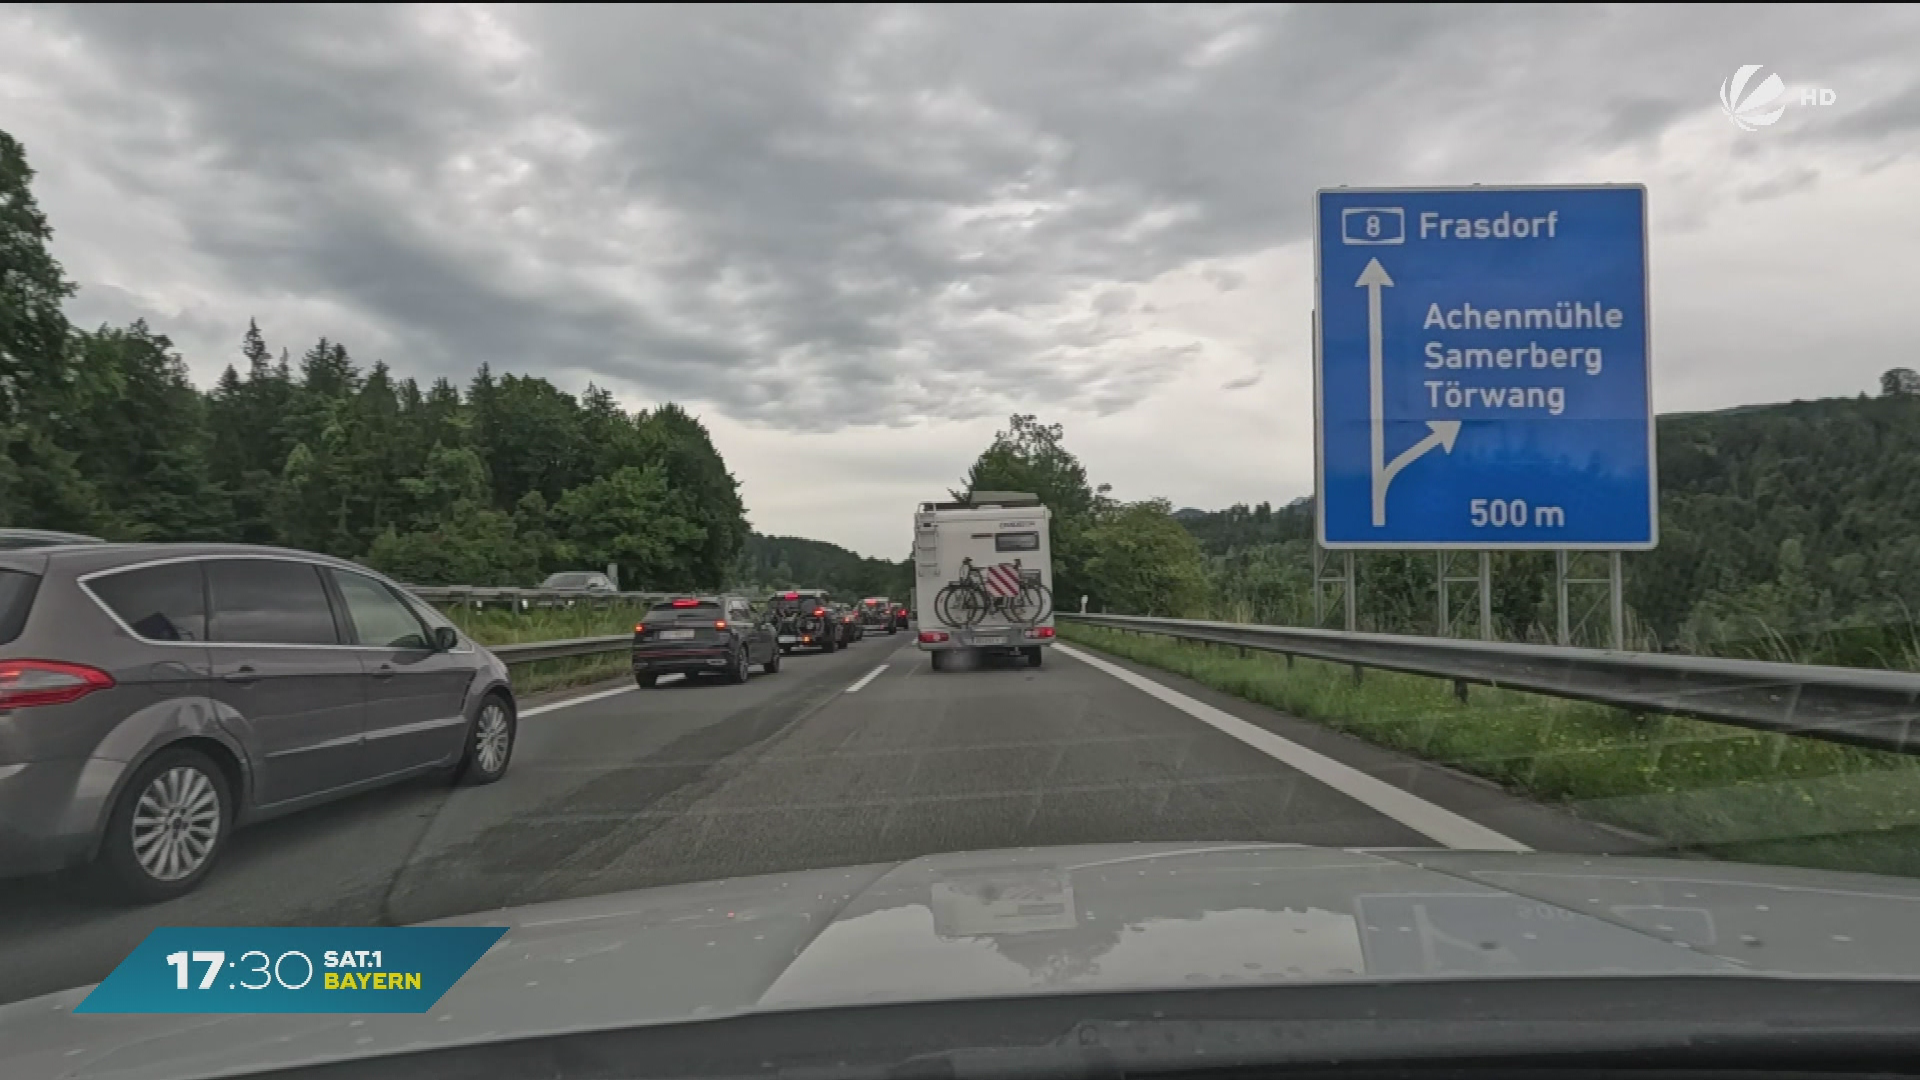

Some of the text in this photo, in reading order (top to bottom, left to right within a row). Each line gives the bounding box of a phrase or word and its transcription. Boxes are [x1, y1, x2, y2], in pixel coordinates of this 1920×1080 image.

[1365, 215, 1381, 237] 8
[1419, 211, 1558, 240] Frasdorf
[1423, 302, 1623, 330] Achenmühle
[1424, 342, 1602, 375] Samerberg
[1424, 381, 1565, 415] Törwang
[1470, 499, 1565, 528] 500 m
